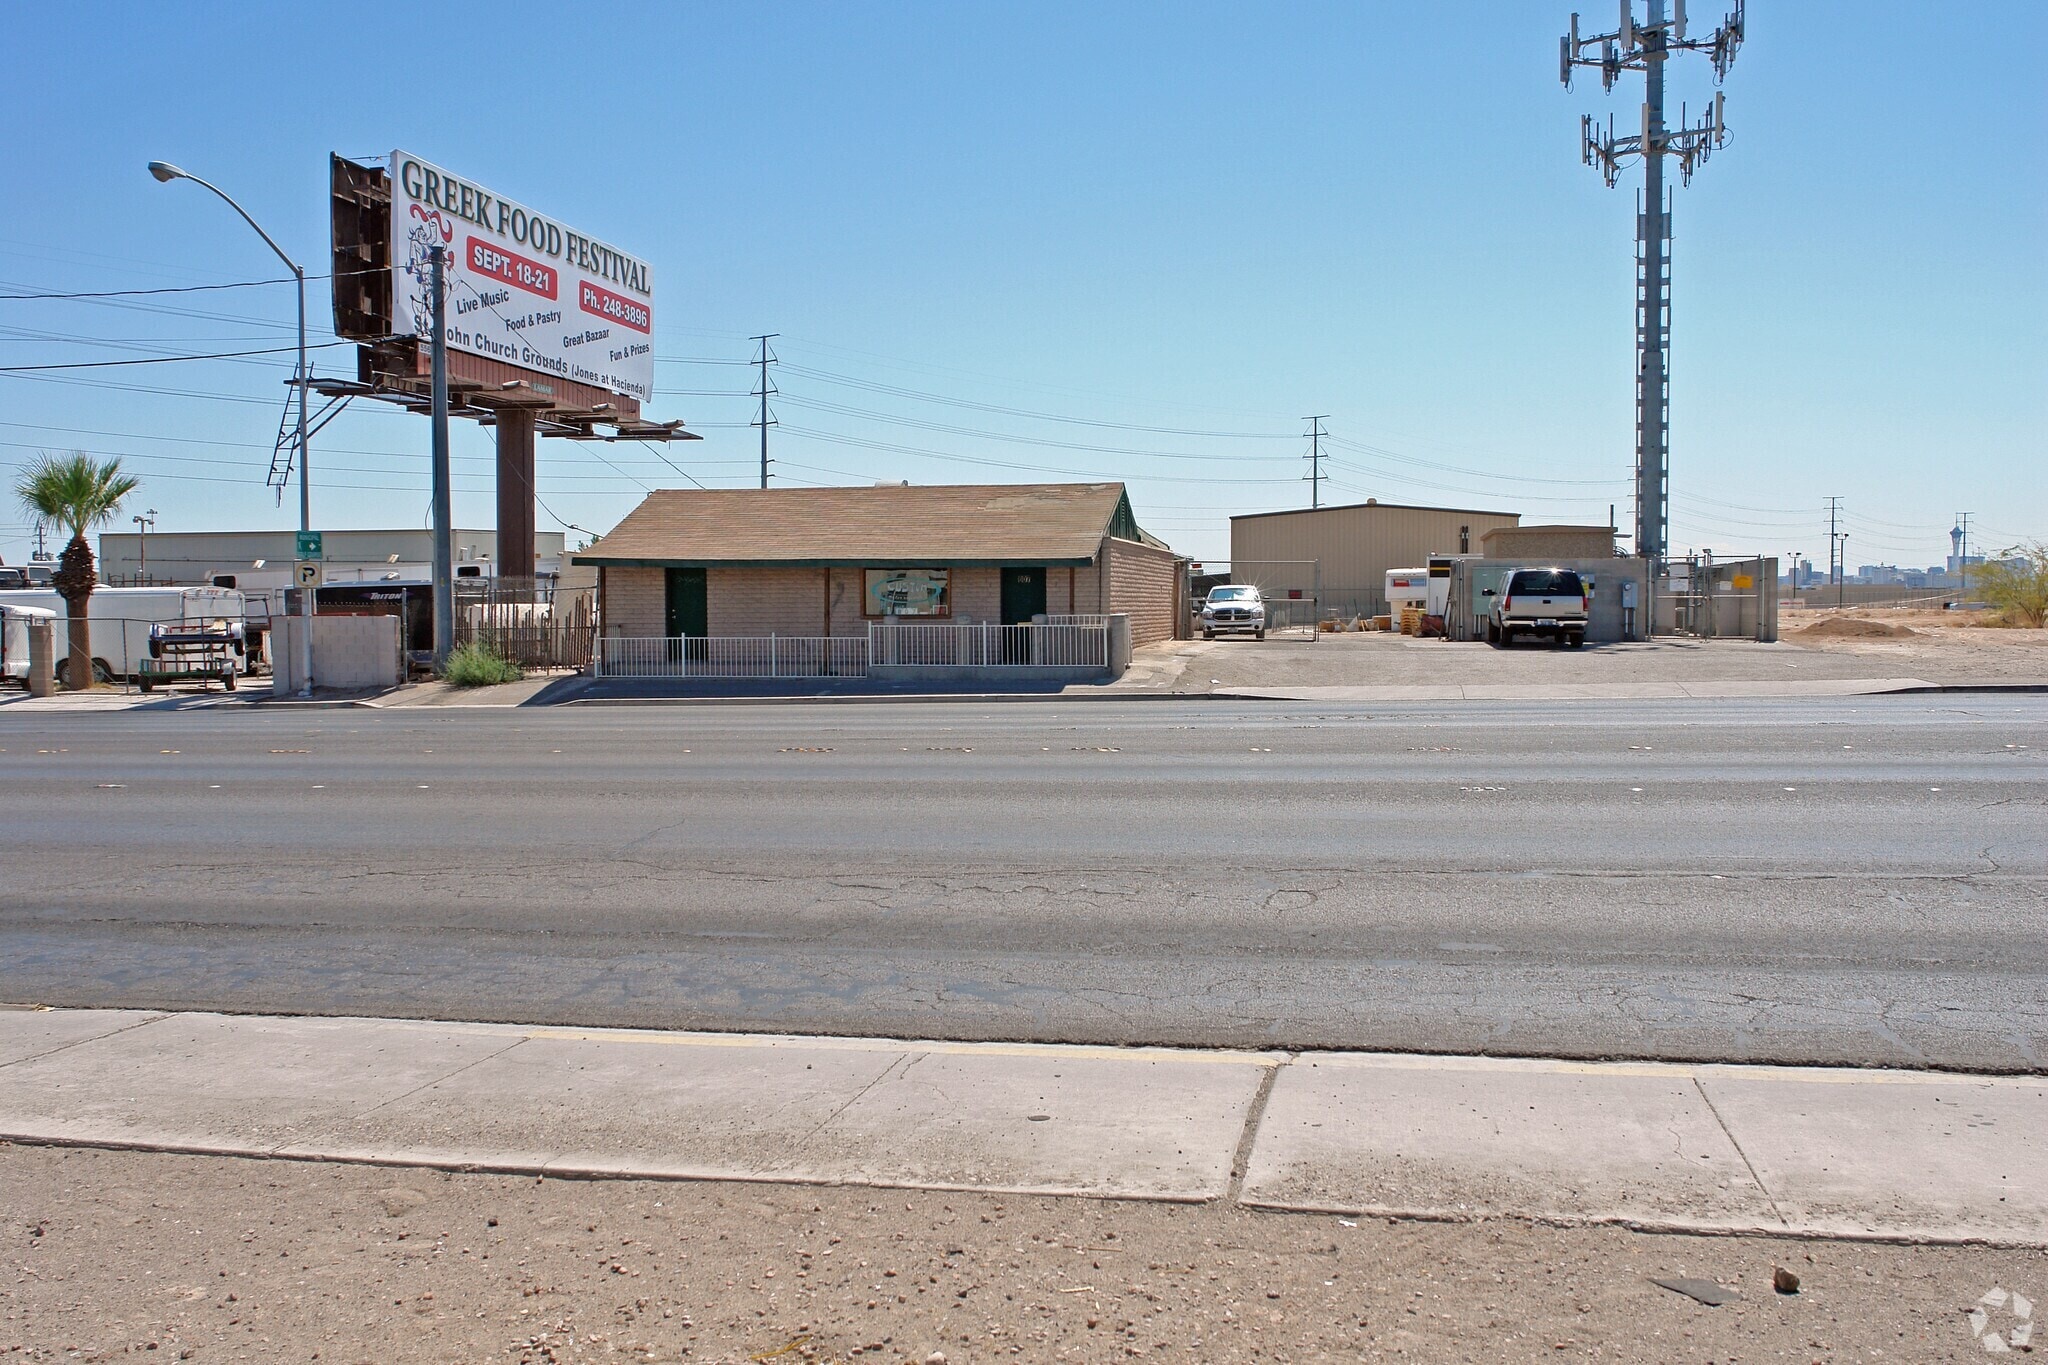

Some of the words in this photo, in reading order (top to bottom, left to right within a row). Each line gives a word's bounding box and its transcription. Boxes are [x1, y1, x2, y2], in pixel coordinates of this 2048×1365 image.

[402, 161, 493, 231] GREEK
[497, 200, 562, 255] FOOD
[565, 231, 650, 294] FESTIVAL
[473, 245, 512, 277] SEPT.
[516, 262, 549, 291] 18-21
[456, 298, 479, 315] Live
[480, 289, 510, 308] Music
[583, 288, 600, 309] Ph.
[603, 295, 648, 327] 248-3896
[506, 317, 526, 332] Food
[528, 314, 535, 327] &
[537, 311, 562, 326] Pastry
[563, 335, 585, 348] Great
[585, 329, 610, 343] Bazaar
[447, 326, 470, 346] ohn
[475, 333, 518, 360] Church
[522, 347, 568, 373] Grounds
[571, 364, 599, 382] (Jones
[601, 374, 610, 386] at
[611, 375, 646, 398] Hacienda)
[610, 350, 623, 362] Fun
[623, 347, 629, 358] &
[630, 343, 650, 356] Prizes
[370, 592, 402, 600] TRITON
